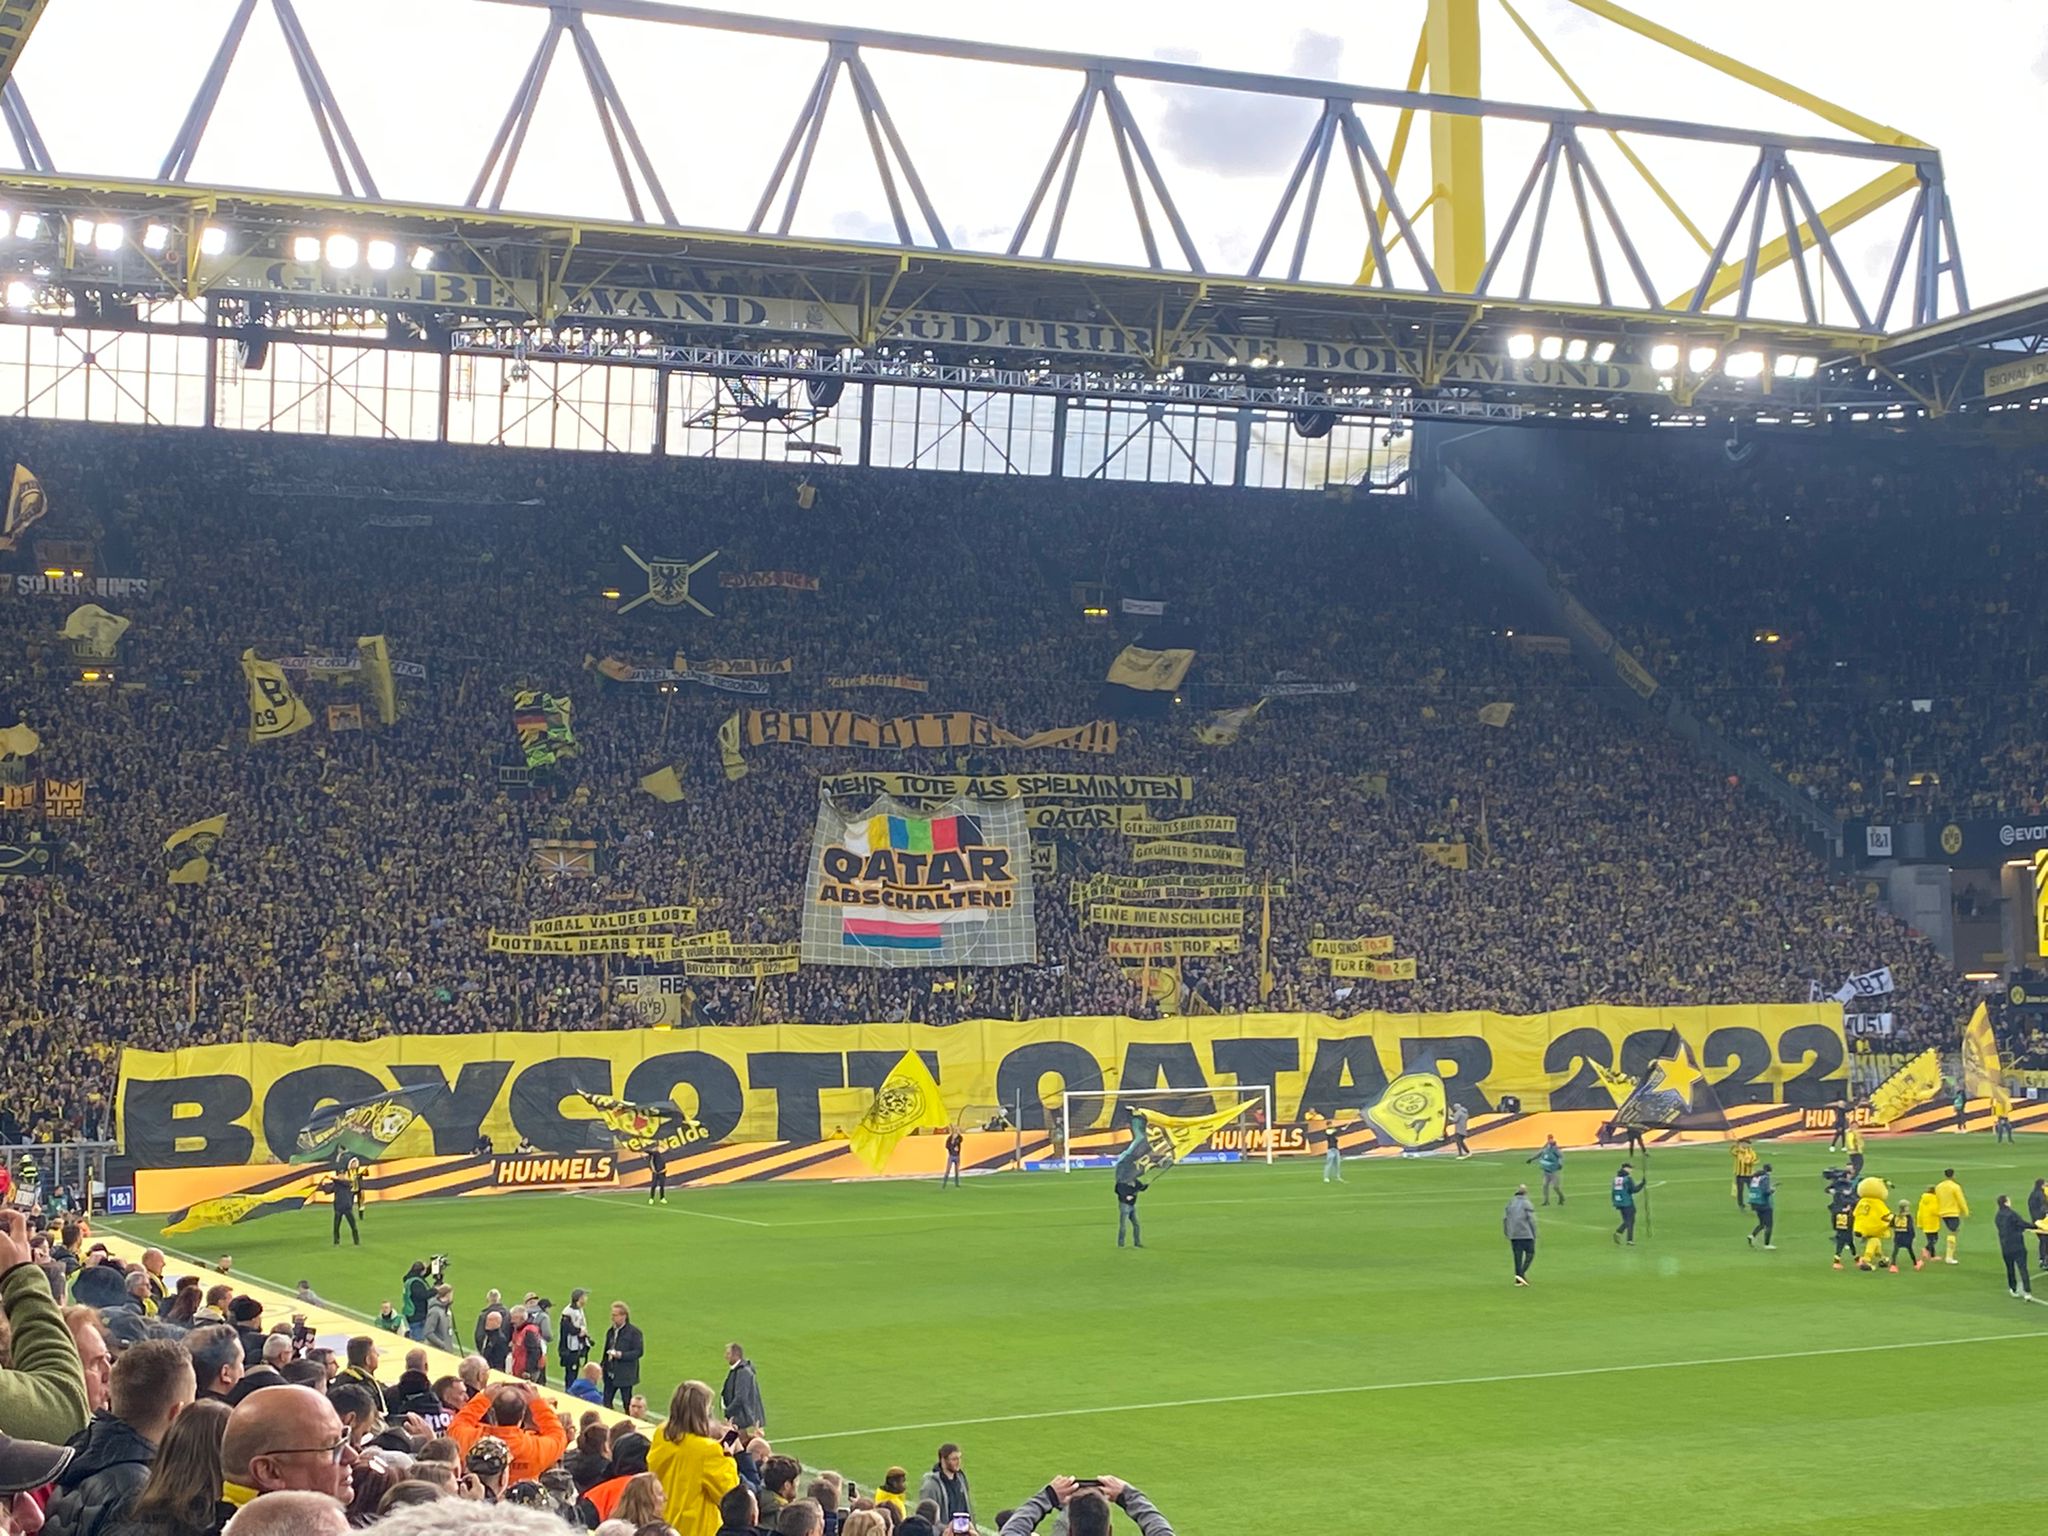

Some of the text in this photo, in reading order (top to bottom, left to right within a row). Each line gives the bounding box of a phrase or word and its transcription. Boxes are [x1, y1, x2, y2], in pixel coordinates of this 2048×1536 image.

[566, 286, 766, 325] WAND
[1304, 342, 1631, 388] DORTMUND
[759, 711, 953, 748] BOYCOTT
[47, 780, 83, 797] WM
[822, 776, 1182, 801] MEHR TOTE ALS SPIELMINUTEN
[1037, 808, 1121, 830] QATAR!
[1204, 819, 1234, 831] STATT
[1870, 833, 1889, 847] 1&1
[823, 847, 1012, 886] QATAR
[821, 885, 1011, 909] ABSCHALTEN!
[534, 919, 583, 934] MORAL
[590, 910, 646, 930] VALUES
[1093, 907, 1241, 925] EINE MENSCHLICHE
[491, 936, 573, 952] FOOTBALL
[579, 937, 629, 951] BEARS
[636, 935, 665, 949] THE
[687, 963, 725, 974] BOYCOTT
[996, 1038, 1493, 1140] QATAR
[1805, 1108, 1873, 1128] HUEL
[1210, 1128, 1302, 1150] HUMMELS
[497, 1156, 612, 1184] HUMMELS
[111, 1192, 131, 1207] 1&1
